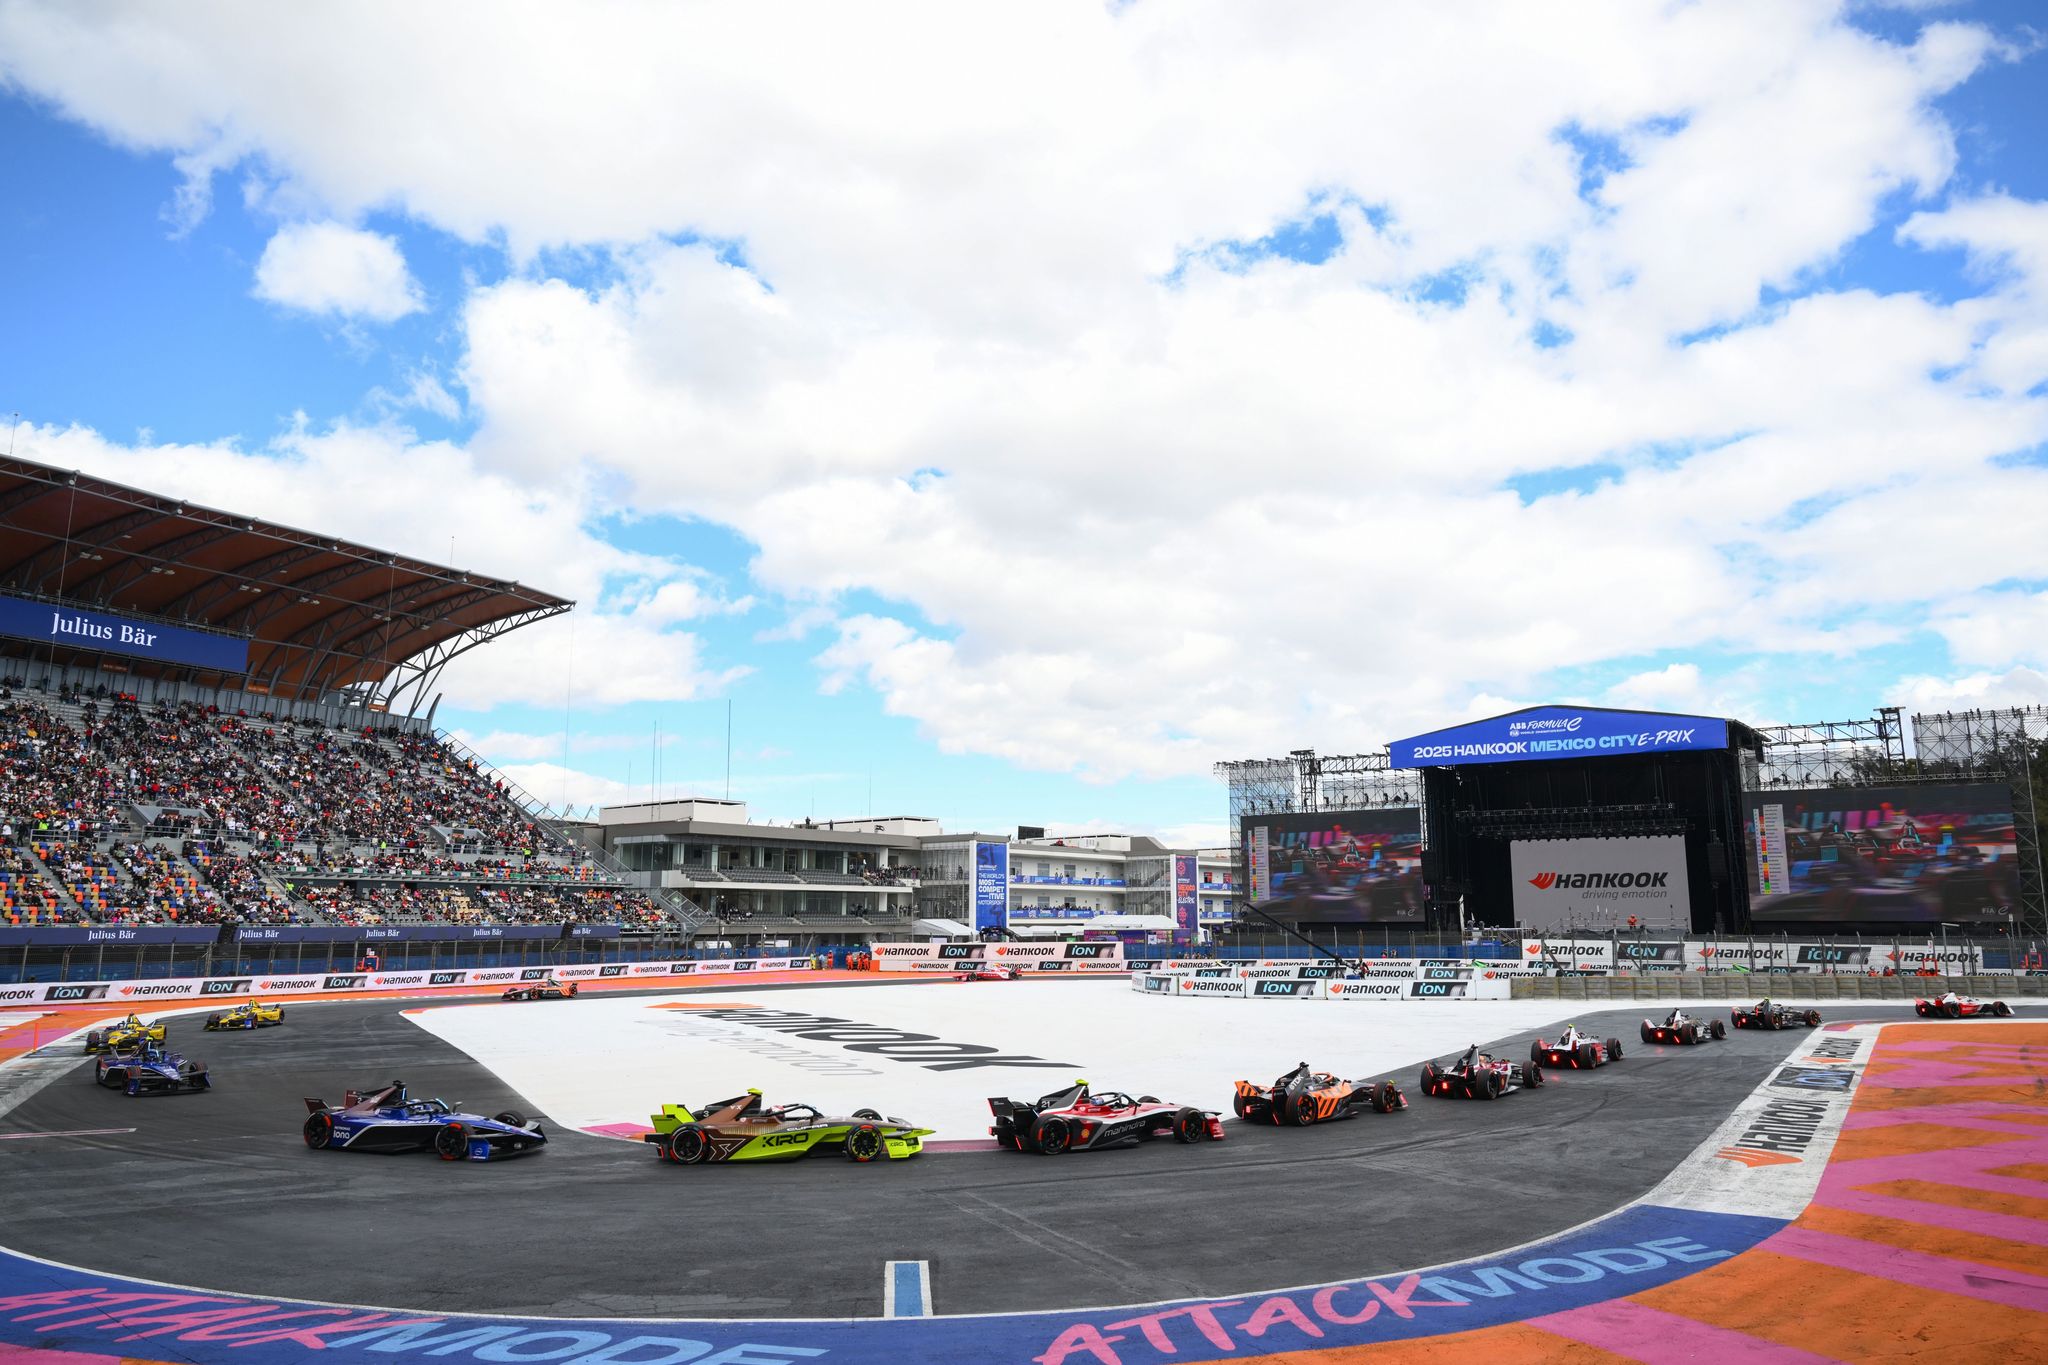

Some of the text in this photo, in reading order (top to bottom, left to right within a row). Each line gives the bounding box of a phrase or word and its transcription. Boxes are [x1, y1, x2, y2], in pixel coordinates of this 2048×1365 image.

[52, 612, 158, 648] Julius Bär
[1527, 718, 1569, 730] FORMULA
[1413, 728, 1694, 759] 2025 HANKOOK MEXICO CITY E-PRIX
[1582, 889, 1667, 901] driving emotion
[88, 930, 136, 941] Julius Bär
[240, 929, 279, 939] Julius Bär
[366, 928, 401, 938] Julius Bär
[473, 928, 503, 937] Julius Bär
[1041, 1100, 1051, 1108] 21
[1104, 1119, 1147, 1138] mahindra
[763, 1132, 809, 1148] KIRO
[1032, 1236, 1733, 1365] ATTACK MODE
[327, 1322, 832, 1365] MODE
